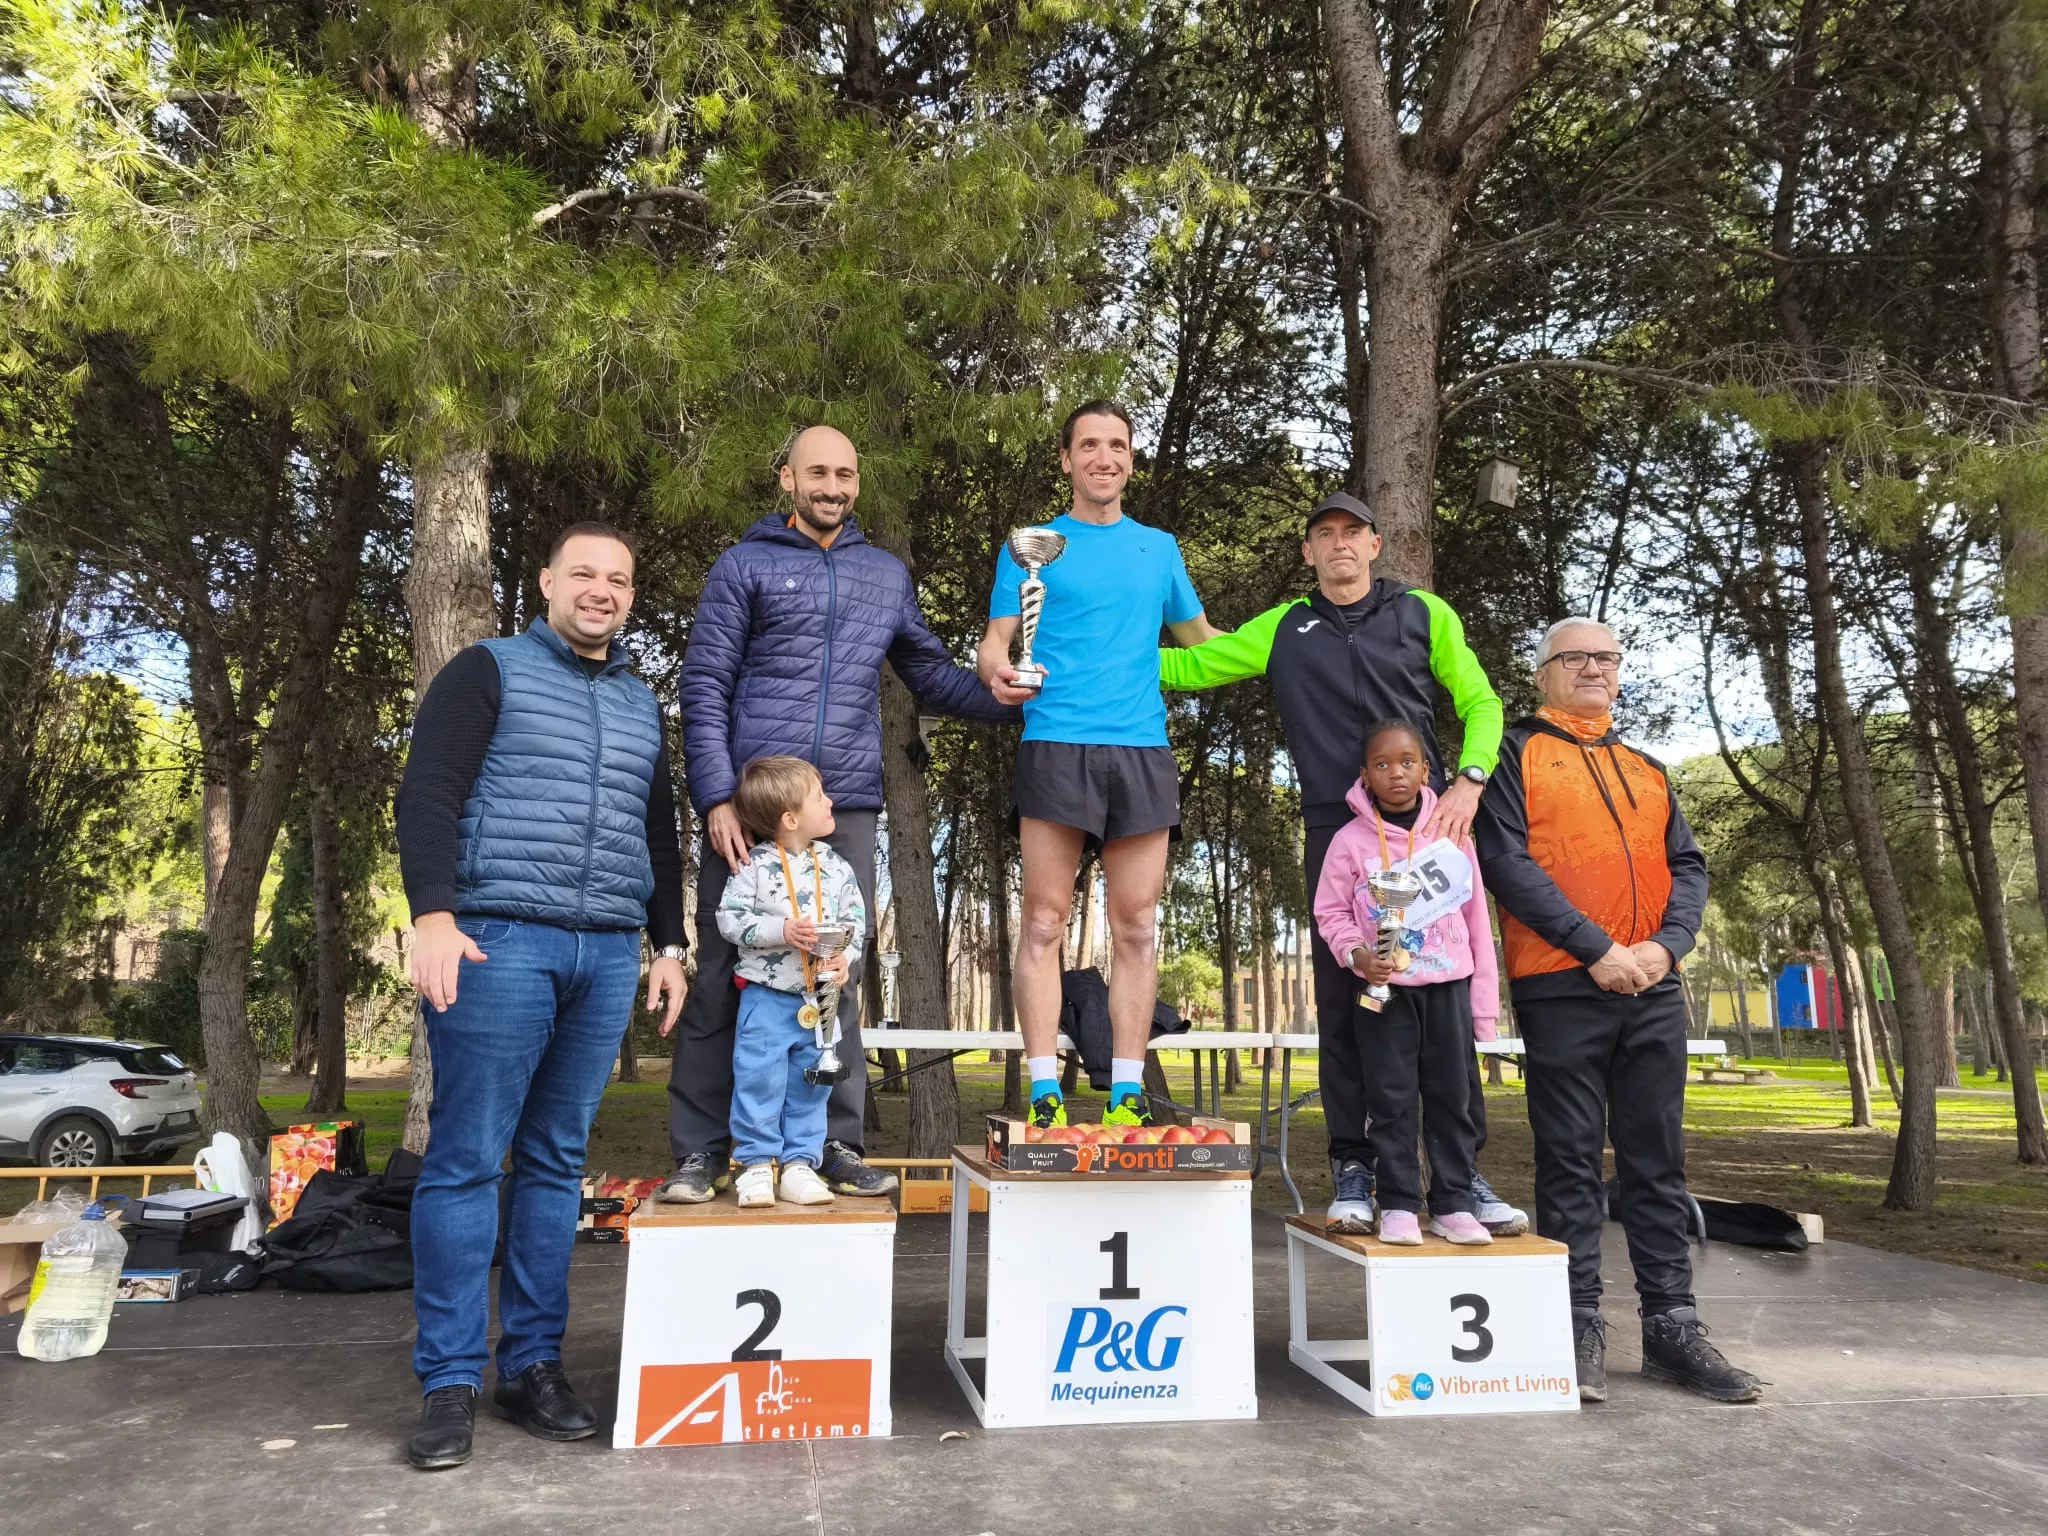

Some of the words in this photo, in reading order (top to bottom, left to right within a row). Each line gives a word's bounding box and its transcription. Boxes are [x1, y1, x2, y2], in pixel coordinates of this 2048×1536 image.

[1107, 1147, 1174, 1169] Ponti
[1099, 1231, 1140, 1300] 1
[731, 1288, 782, 1362] 2
[1052, 1305, 1188, 1373] P&G
[1450, 1293, 1493, 1363] 3
[1051, 1381, 1178, 1405] Mequinenza
[1439, 1375, 1510, 1395] Vibrant
[1515, 1374, 1570, 1396] Living
